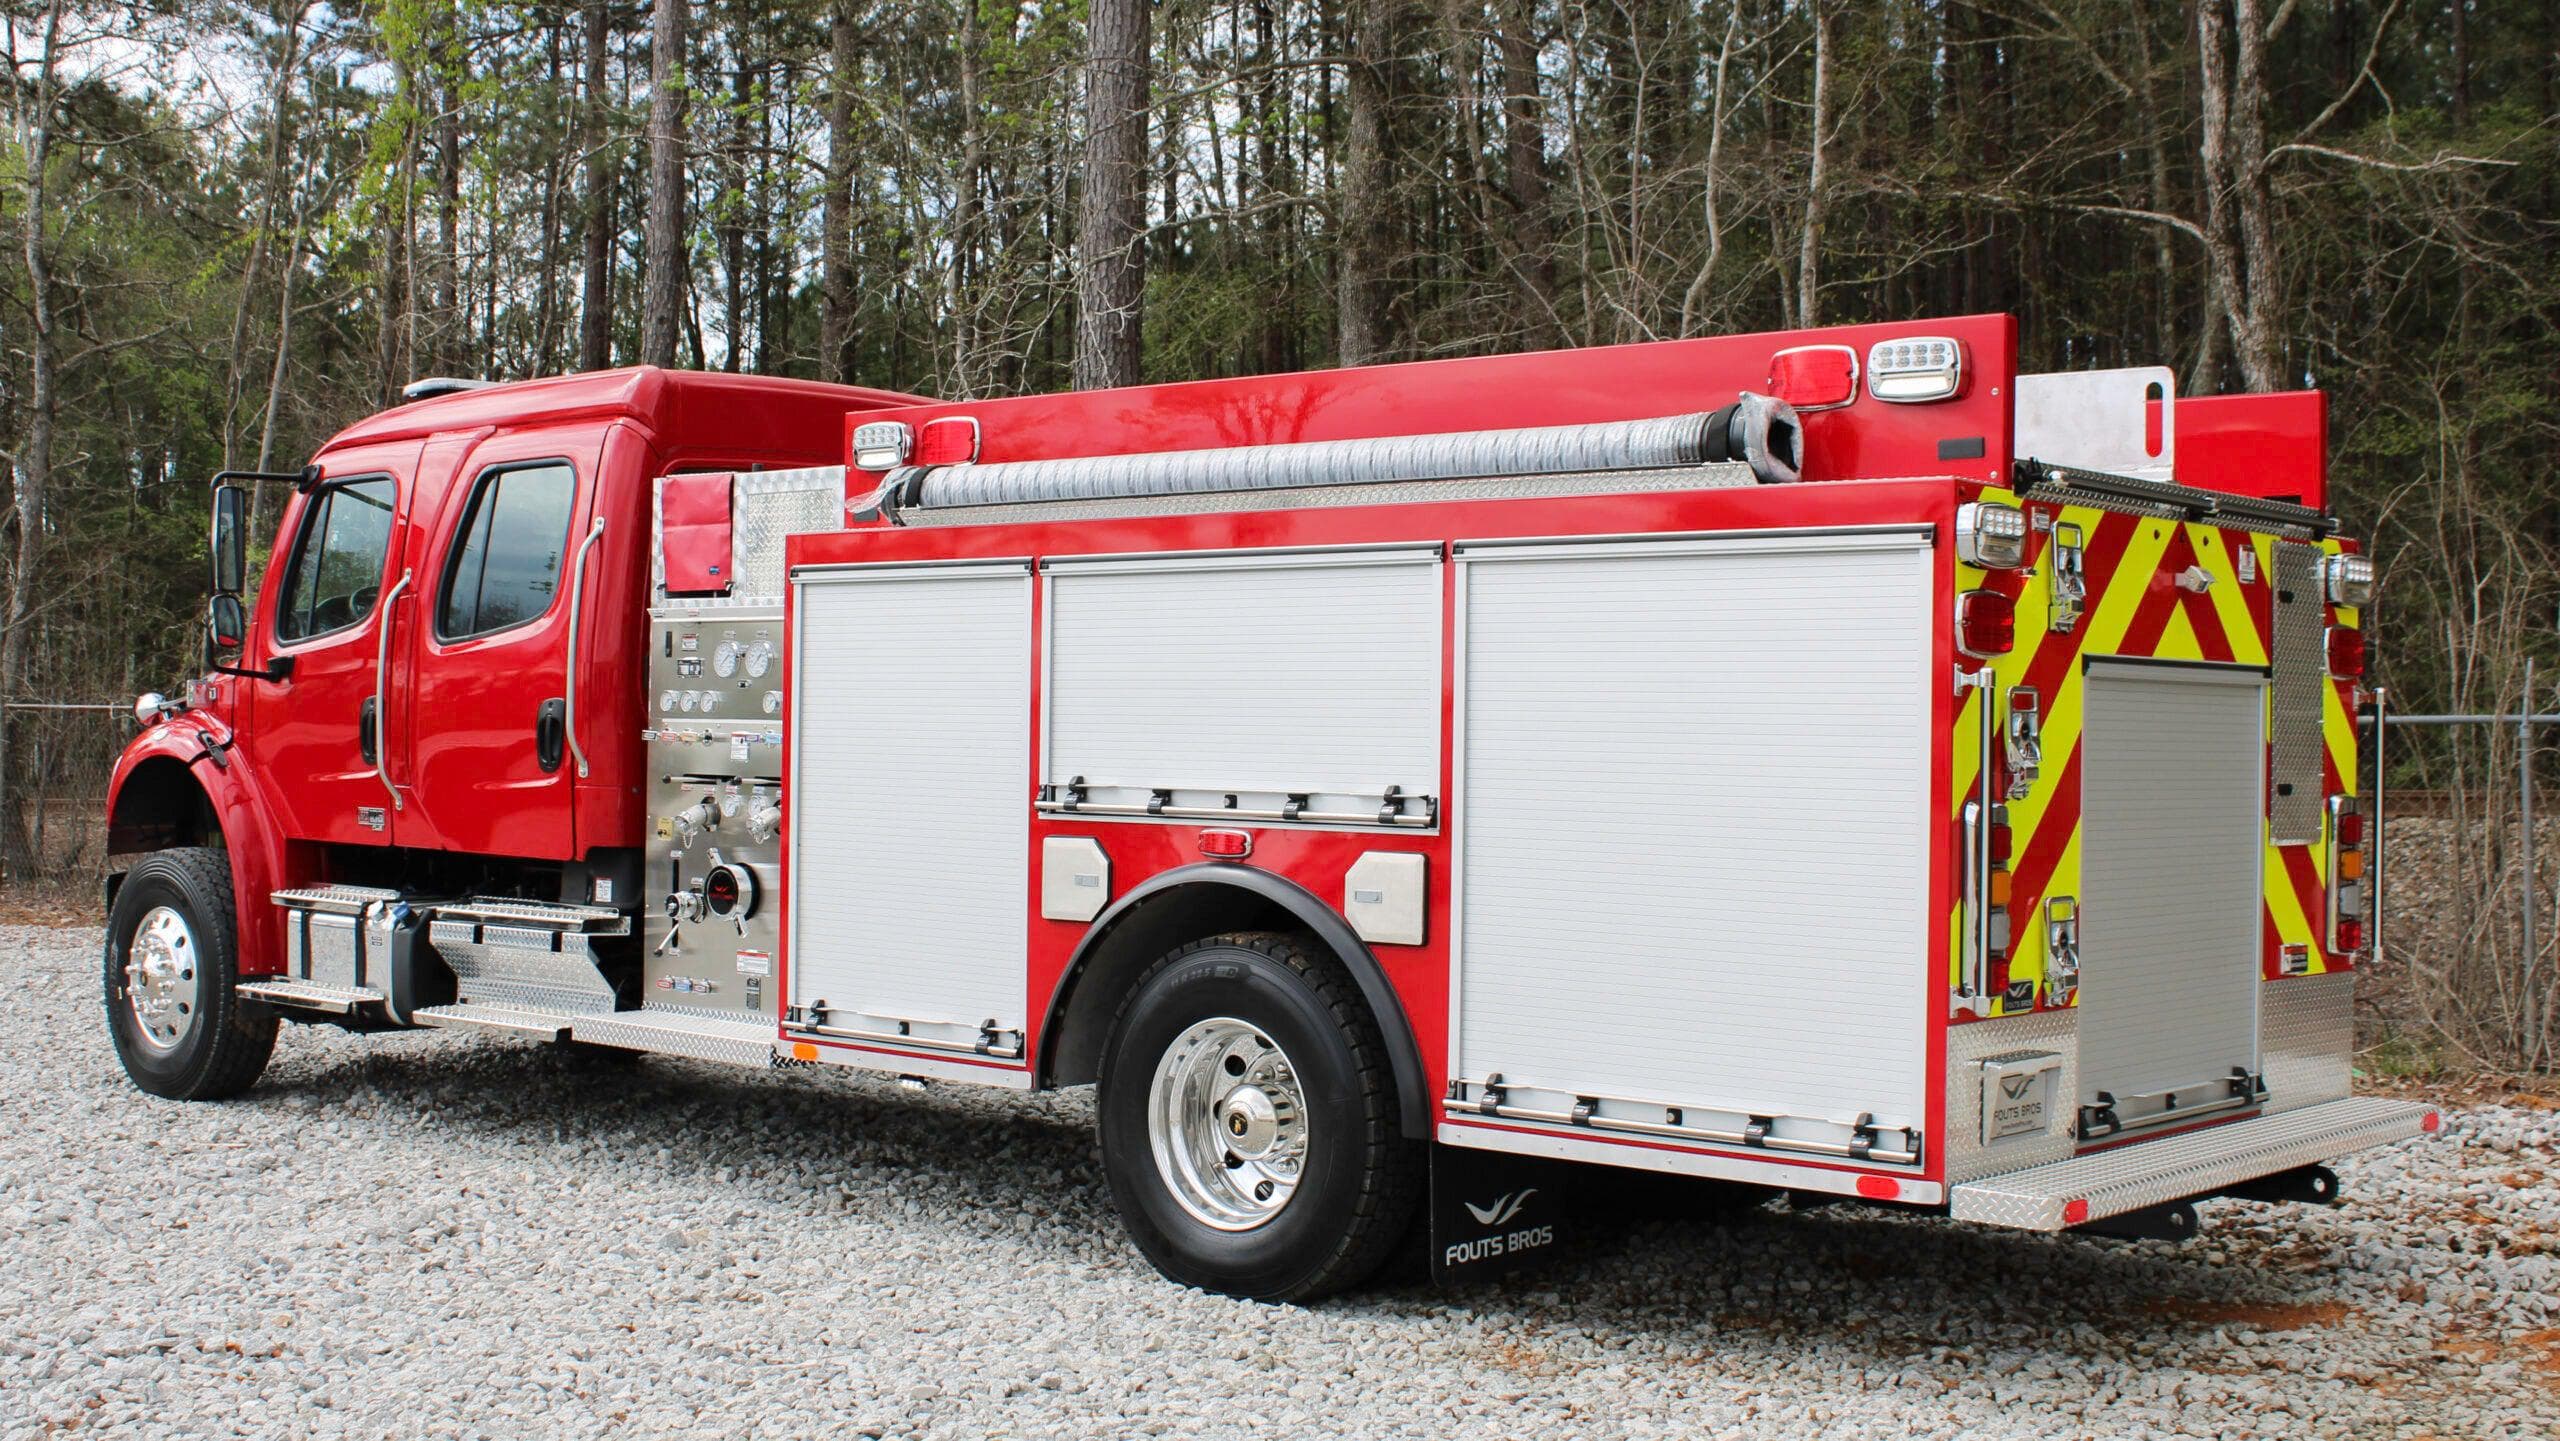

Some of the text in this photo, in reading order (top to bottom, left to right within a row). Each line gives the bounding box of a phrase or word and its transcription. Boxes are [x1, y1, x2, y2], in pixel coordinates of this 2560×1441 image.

[1994, 1102, 2041, 1121] FOUTS BROS
[1446, 1226, 1553, 1266] FOUTS BROS
